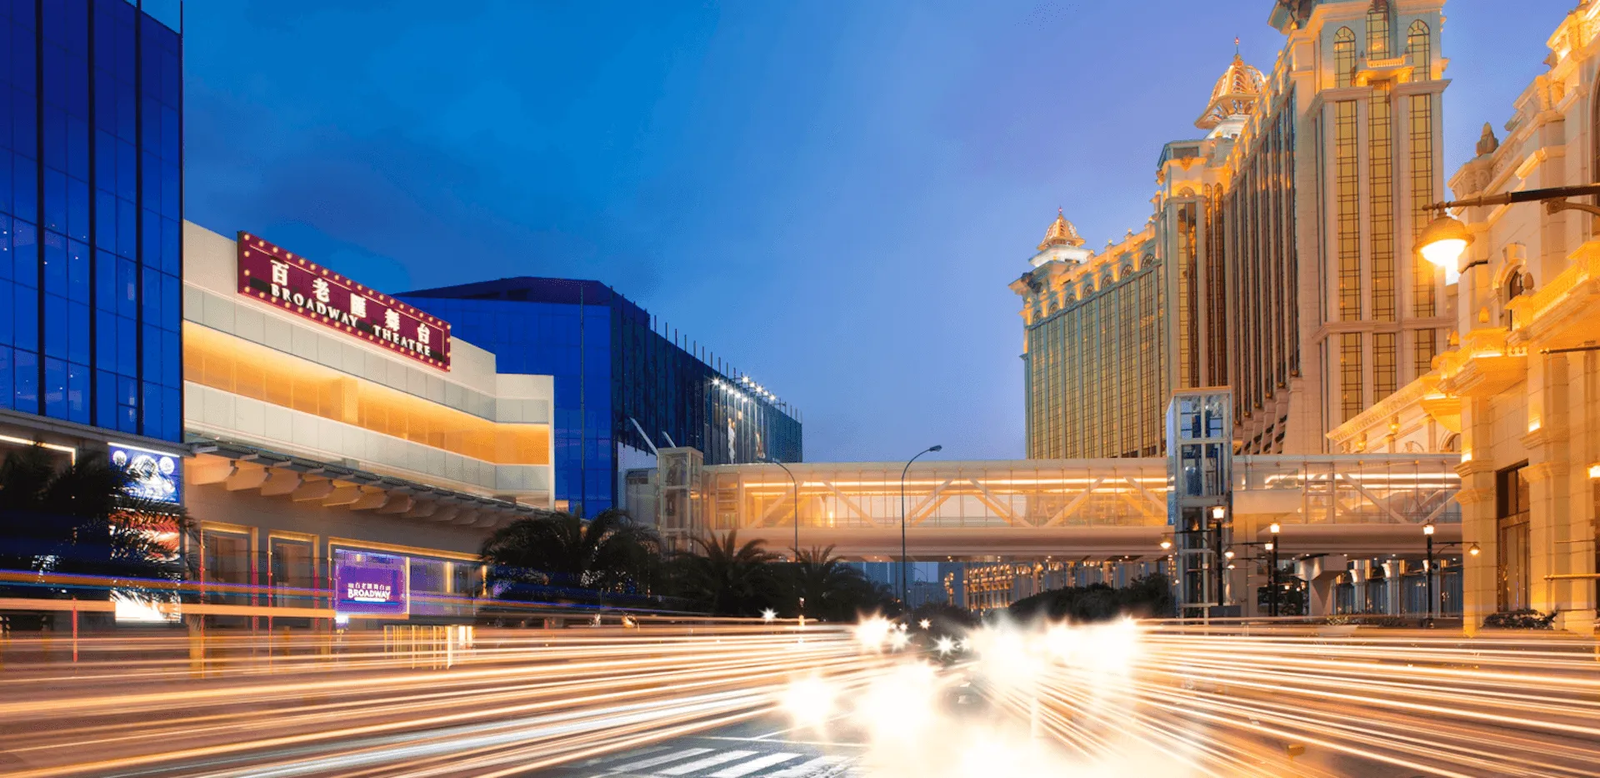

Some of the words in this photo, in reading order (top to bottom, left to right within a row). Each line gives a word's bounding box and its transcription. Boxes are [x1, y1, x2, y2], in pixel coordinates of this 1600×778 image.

[270, 259, 431, 344] 百老匯舞台
[270, 284, 359, 327] BROADWAY
[373, 325, 431, 357] THEATRE
[347, 588, 391, 600] BROADWAY
